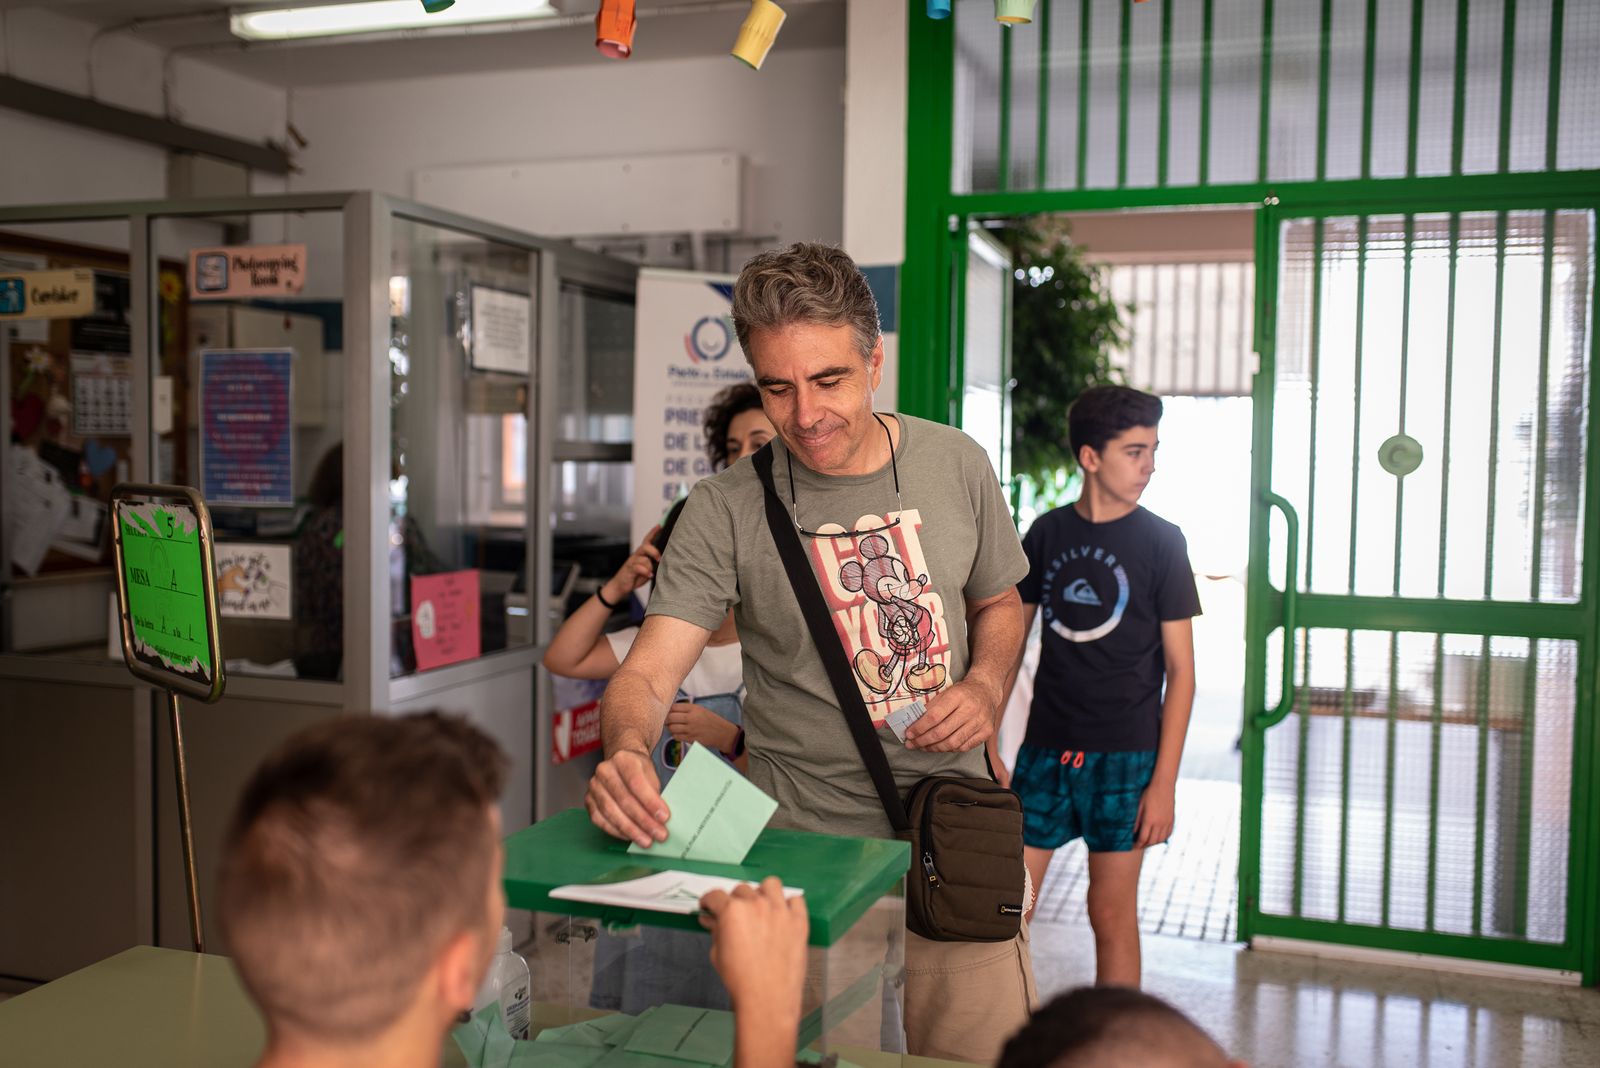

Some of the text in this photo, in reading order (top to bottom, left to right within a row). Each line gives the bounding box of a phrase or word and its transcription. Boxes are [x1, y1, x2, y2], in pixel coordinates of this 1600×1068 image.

[664, 432, 688, 451] DE
[663, 458, 688, 476] DE
[166, 516, 174, 539] 5
[129, 566, 178, 592] MESA A
[1042, 545, 1117, 620] QUIKSILVER
[188, 623, 195, 642] L
